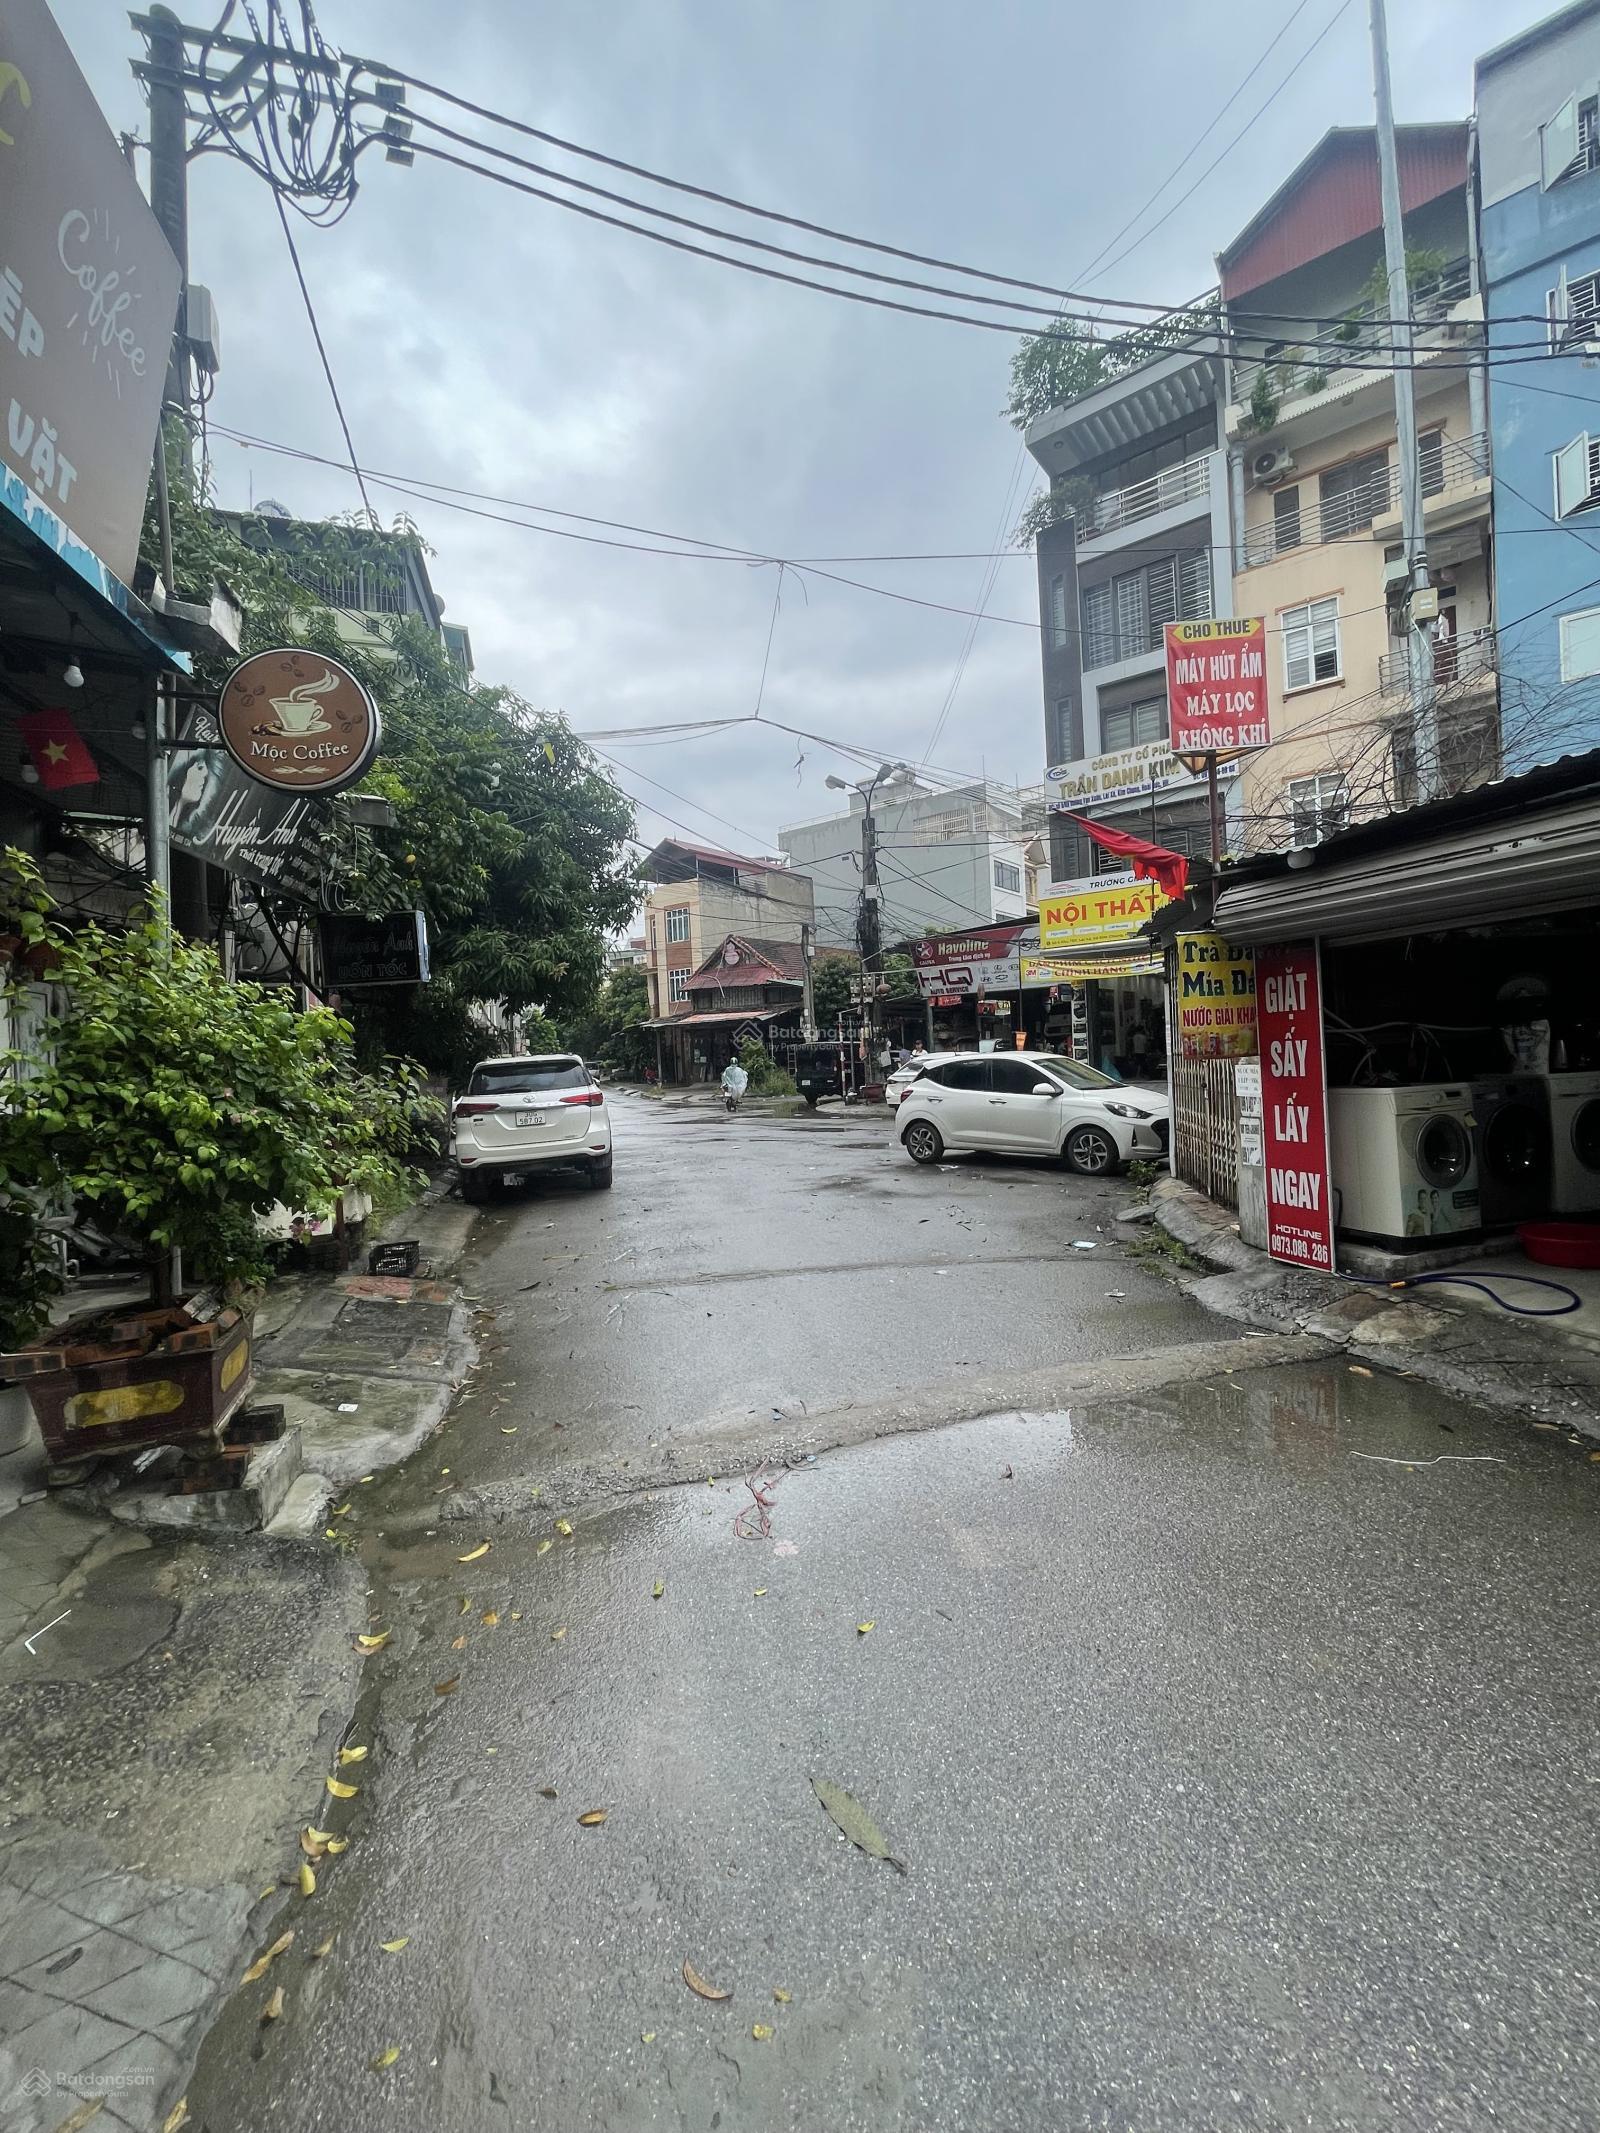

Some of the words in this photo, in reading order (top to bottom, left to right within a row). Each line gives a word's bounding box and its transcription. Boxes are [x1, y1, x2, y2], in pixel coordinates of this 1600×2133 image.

[58, 209, 146, 376] Coffee
[8, 398, 77, 504] VẶT
[1183, 623, 1211, 639] CHO
[1175, 652, 1206, 685] MÁY
[1210, 649, 1236, 681] HÚT
[1240, 642, 1263, 678] ẨM
[1186, 688, 1221, 717] MÁY
[1225, 690, 1255, 718] LỌC
[1178, 722, 1235, 750] KHÔNG
[1238, 717, 1267, 745] KHÍ
[250, 740, 288, 763] Mộc
[293, 742, 350, 760] Coffee
[1091, 757, 1118, 771] CÔNG
[1120, 753, 1134, 765] TY
[1101, 764, 1144, 790] DANH
[1148, 758, 1181, 781] KIM
[193, 789, 261, 861] Huyền
[257, 798, 310, 845] Anh
[1089, 875, 1126, 889] TRƯỜNG
[1046, 902, 1087, 927] NỘI
[1094, 887, 1160, 919] THẤT
[937, 940, 989, 956] Havoline
[1183, 940, 1220, 963] Trà
[917, 966, 974, 988] HQ
[1182, 969, 1225, 998] Mía
[1265, 966, 1308, 1020] GIẶT
[1183, 1006, 1212, 1027] NƯỚC
[1215, 1002, 1234, 1026] GIẢI
[1270, 1026, 1308, 1078] SẤY
[1274, 1092, 1309, 1143] LẤY
[1270, 1168, 1320, 1211] NGAY
[1275, 1224, 1322, 1240] HOTLINE
[1311, 1244, 1329, 1263] 286
